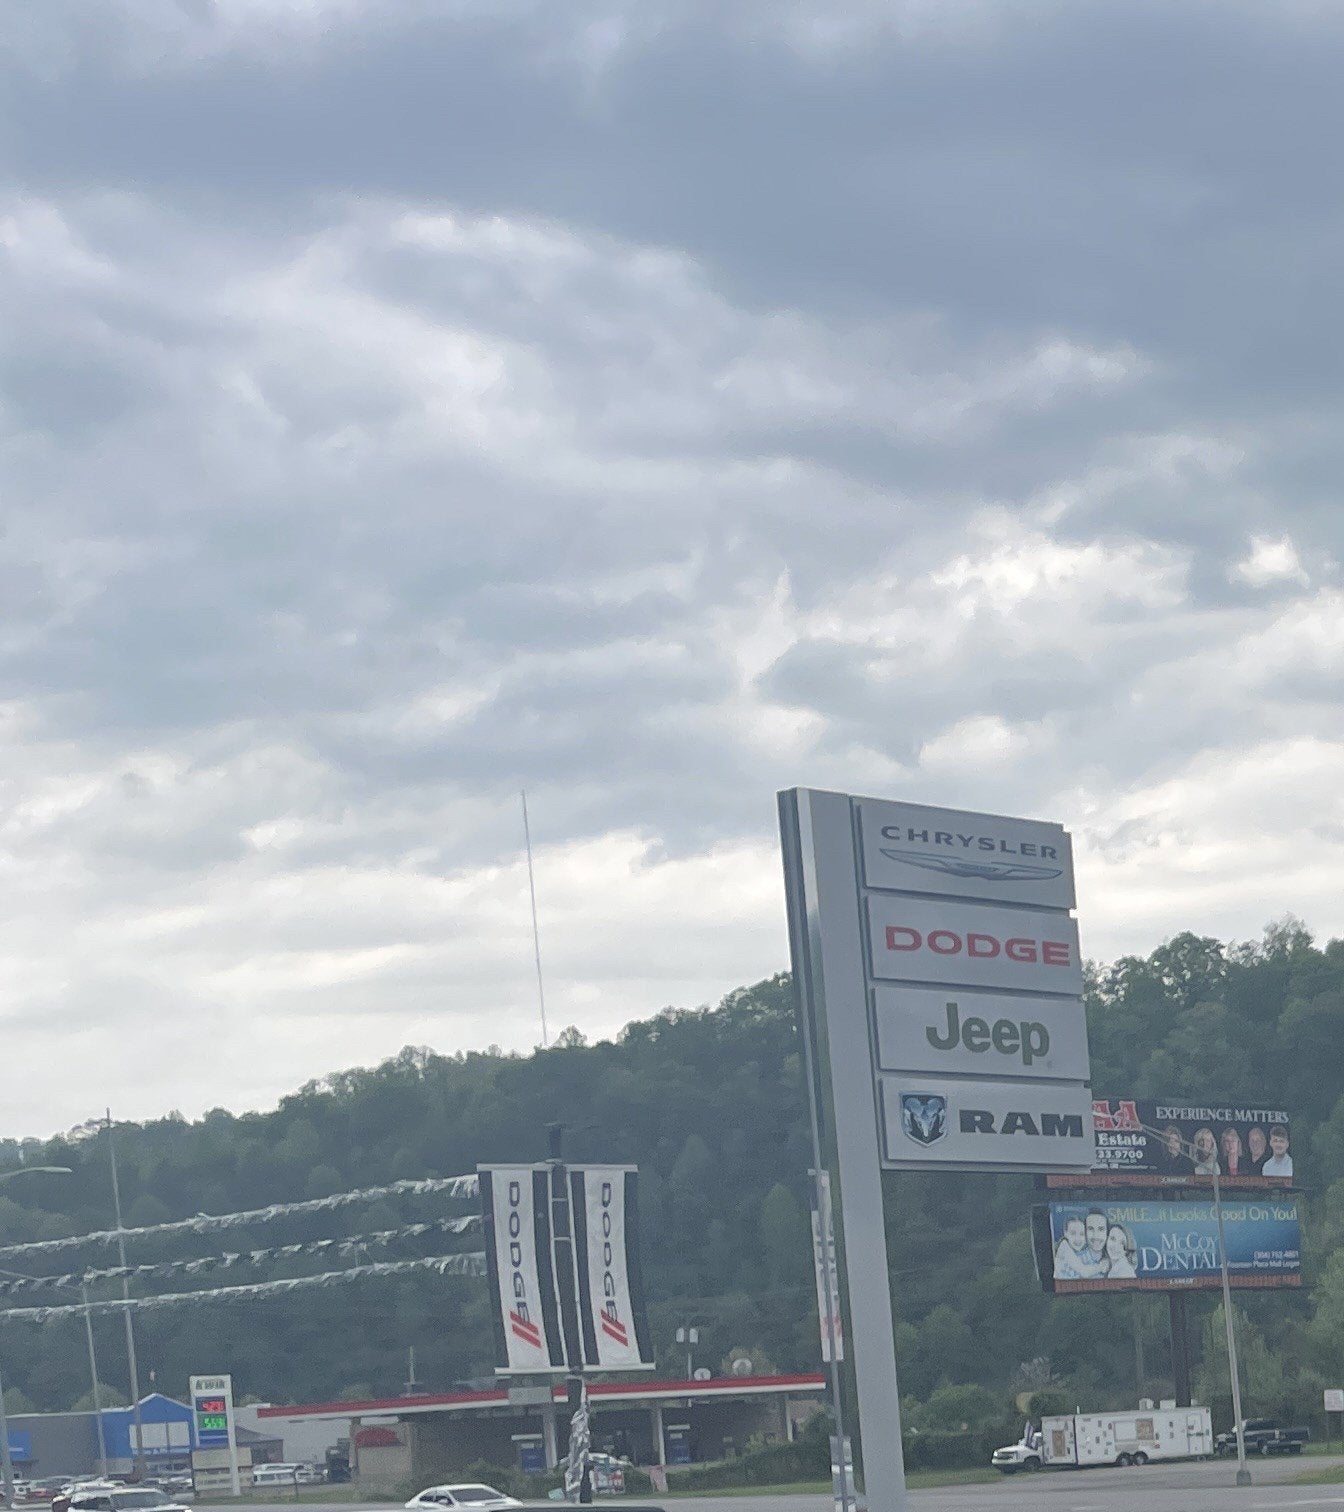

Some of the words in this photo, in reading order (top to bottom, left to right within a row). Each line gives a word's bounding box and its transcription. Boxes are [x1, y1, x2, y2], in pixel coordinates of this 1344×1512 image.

[881, 825, 1058, 860] CHRYSLER
[885, 925, 1071, 967] DODGE
[926, 1002, 1050, 1066] Jeep
[959, 1108, 1084, 1138] RAM
[1155, 1106, 1233, 1120] EXPERIENCE
[1234, 1109, 1290, 1124] MATTERS
[1098, 1132, 1147, 1146] Estate
[1249, 1206, 1269, 1220] On
[509, 1181, 530, 1325] DODGE
[602, 1182, 618, 1323] DODGE
[1140, 1246, 1220, 1270] DENTAL
